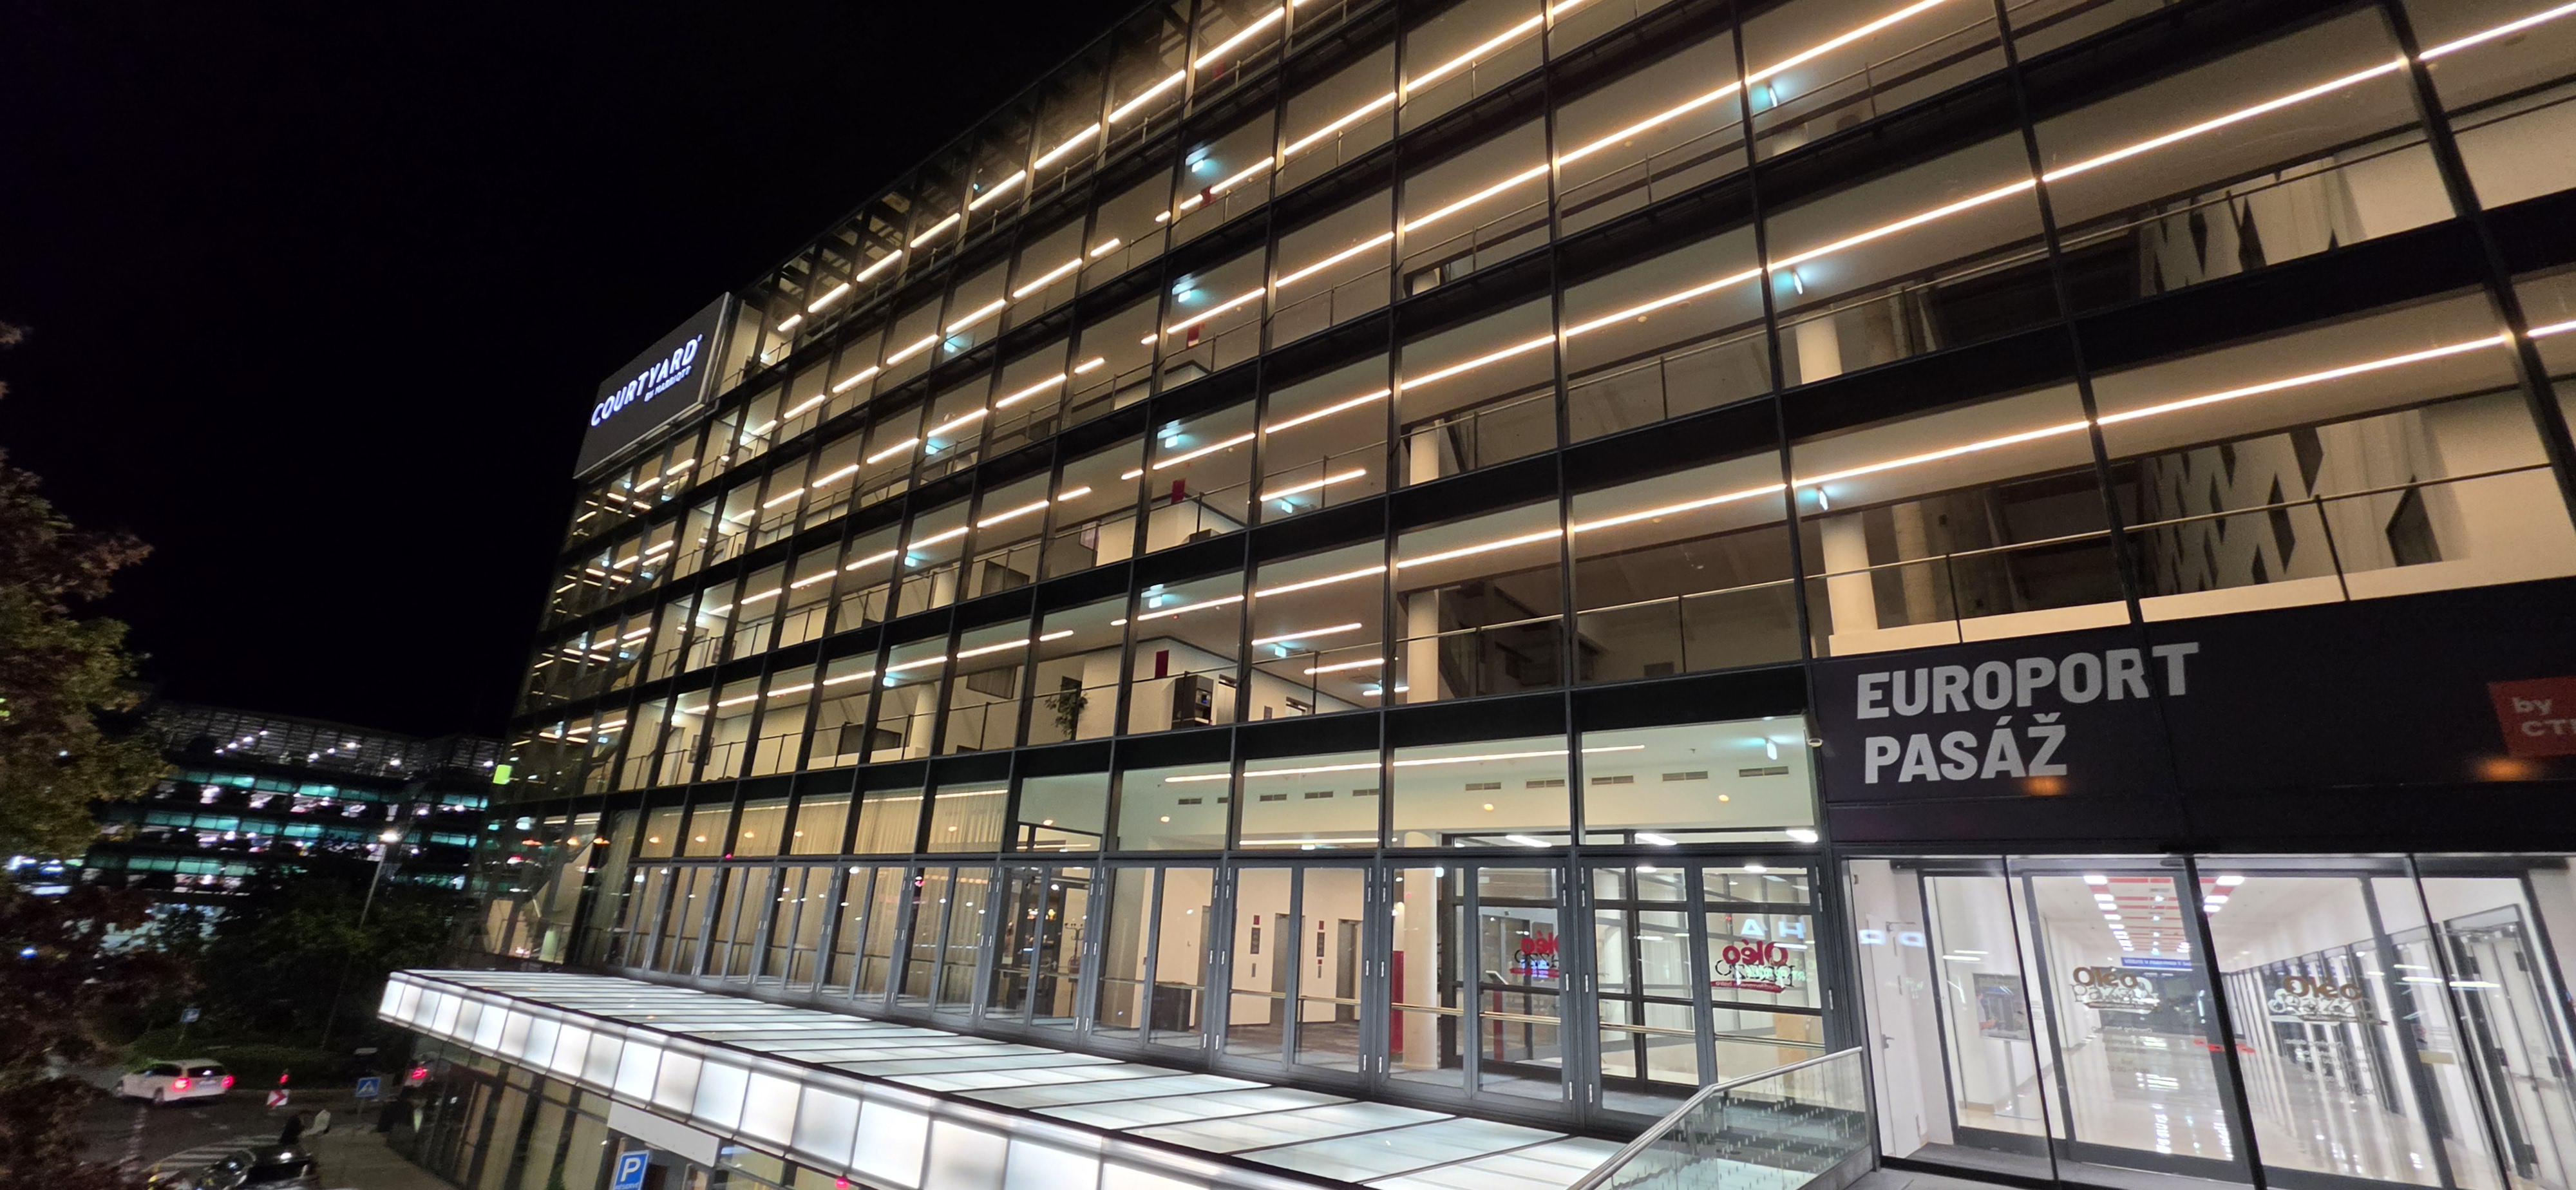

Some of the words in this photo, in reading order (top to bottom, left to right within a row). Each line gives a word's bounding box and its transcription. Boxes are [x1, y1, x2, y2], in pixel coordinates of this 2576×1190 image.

[591, 337, 699, 426] COURTYARD
[655, 365, 692, 395] MARRIOTT
[1857, 642, 2199, 720] EUROPORT
[2512, 697, 2552, 716] by
[1864, 712, 2068, 784] PASÁŽ
[620, 1157, 641, 1182] P
